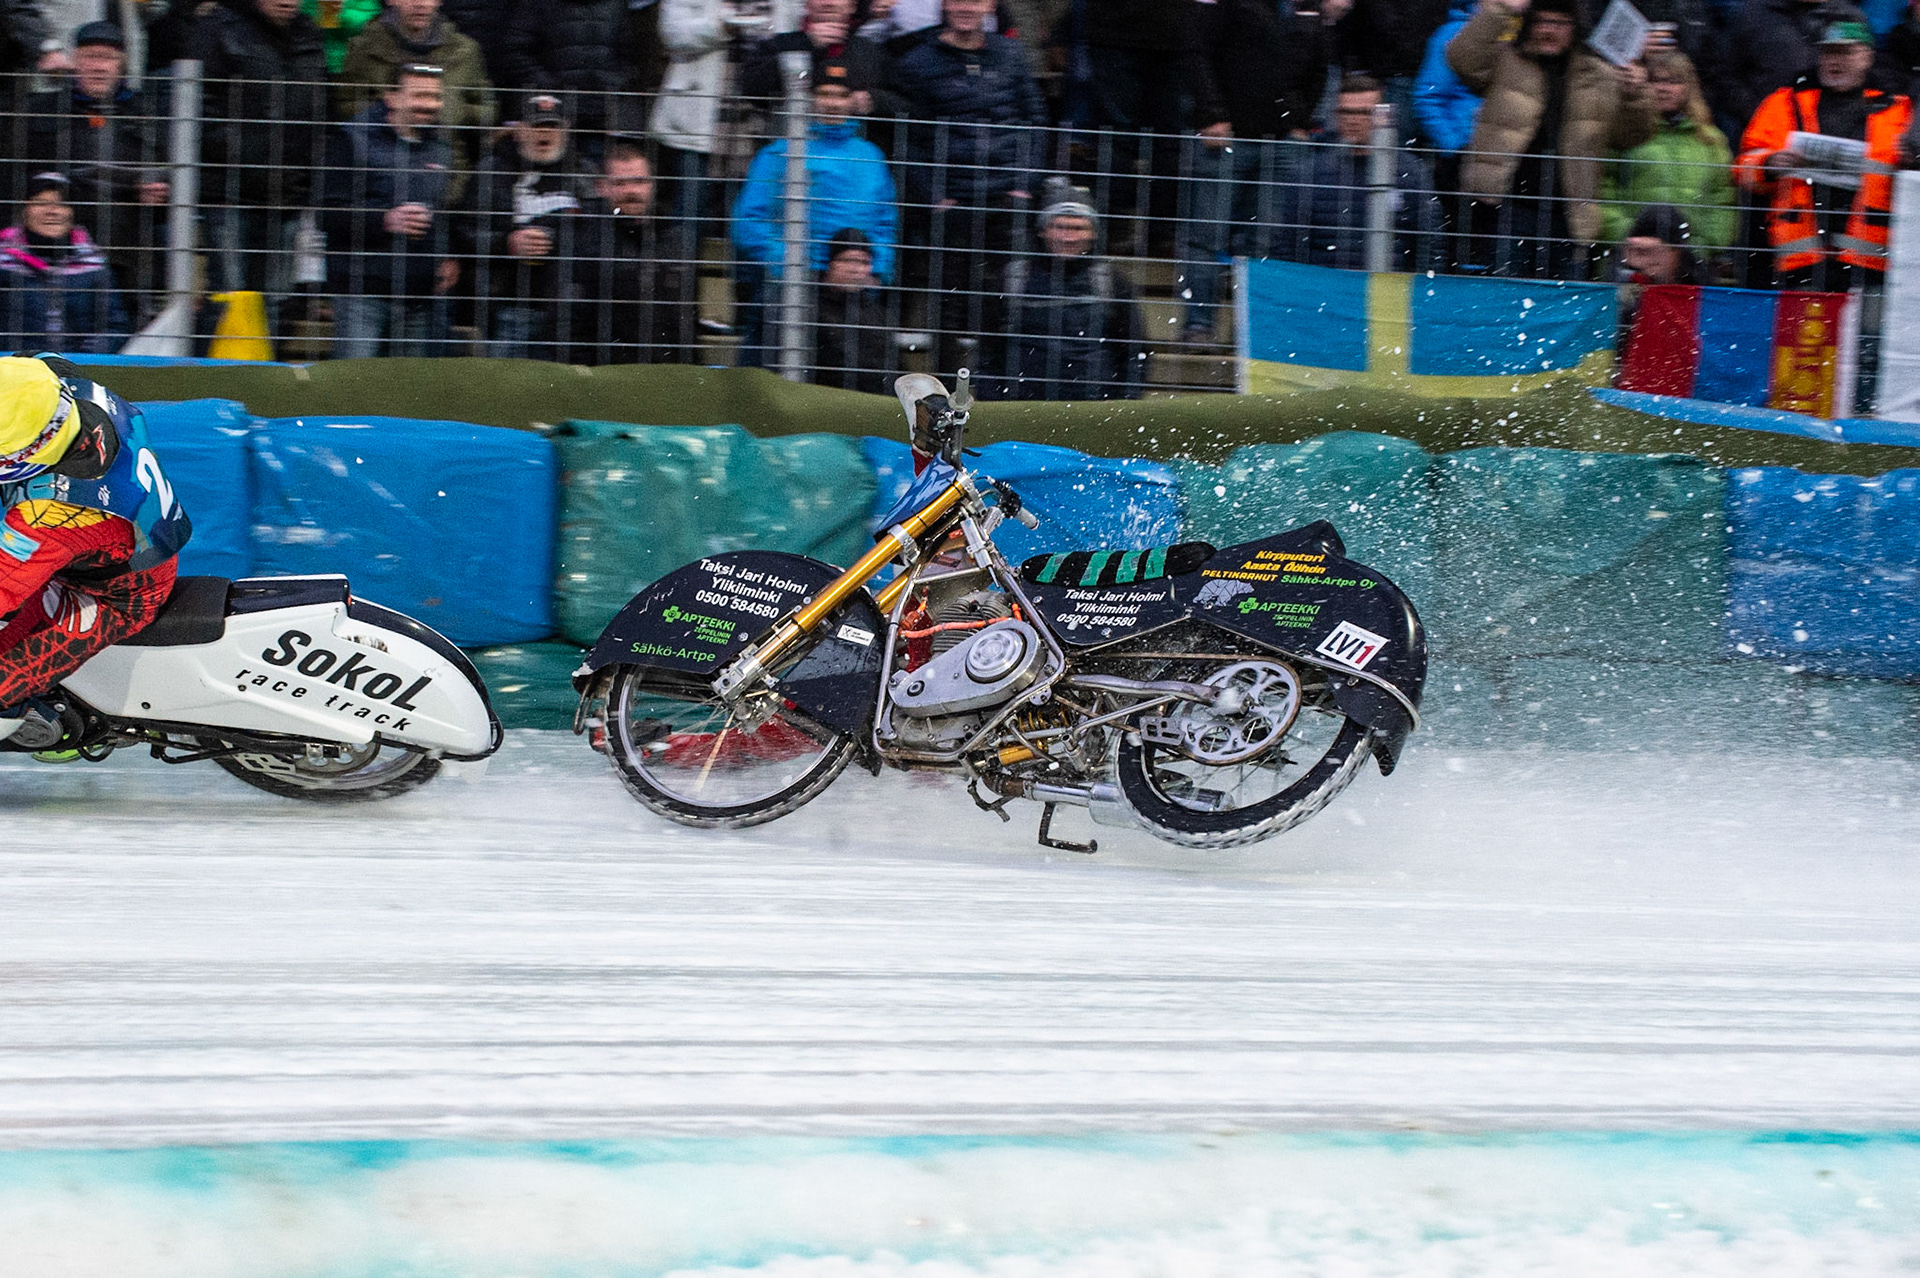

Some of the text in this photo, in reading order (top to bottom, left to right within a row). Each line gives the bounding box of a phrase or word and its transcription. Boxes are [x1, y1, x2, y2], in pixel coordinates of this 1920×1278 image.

[1255, 550, 1326, 562] Kirpputori
[1240, 560, 1281, 571] Aasta
[699, 558, 809, 595] Taksi Jari Holmi
[1201, 569, 1279, 582] PELTIKARHUT
[1281, 574, 1378, 589] Sähkö-Artpe Oy
[711, 576, 783, 604] Ylikiiminki
[1064, 589, 1167, 602] Taksi Jari Holmi
[695, 589, 780, 619] 0500 584580
[1074, 601, 1141, 614] Ylikiiminki
[1258, 602, 1321, 615] APTEEKKI
[680, 612, 737, 632] APTEEKKI
[1056, 613, 1138, 627] 0500 584580
[631, 642, 716, 662] Sähkö-Artpe
[235, 668, 412, 731] race track
